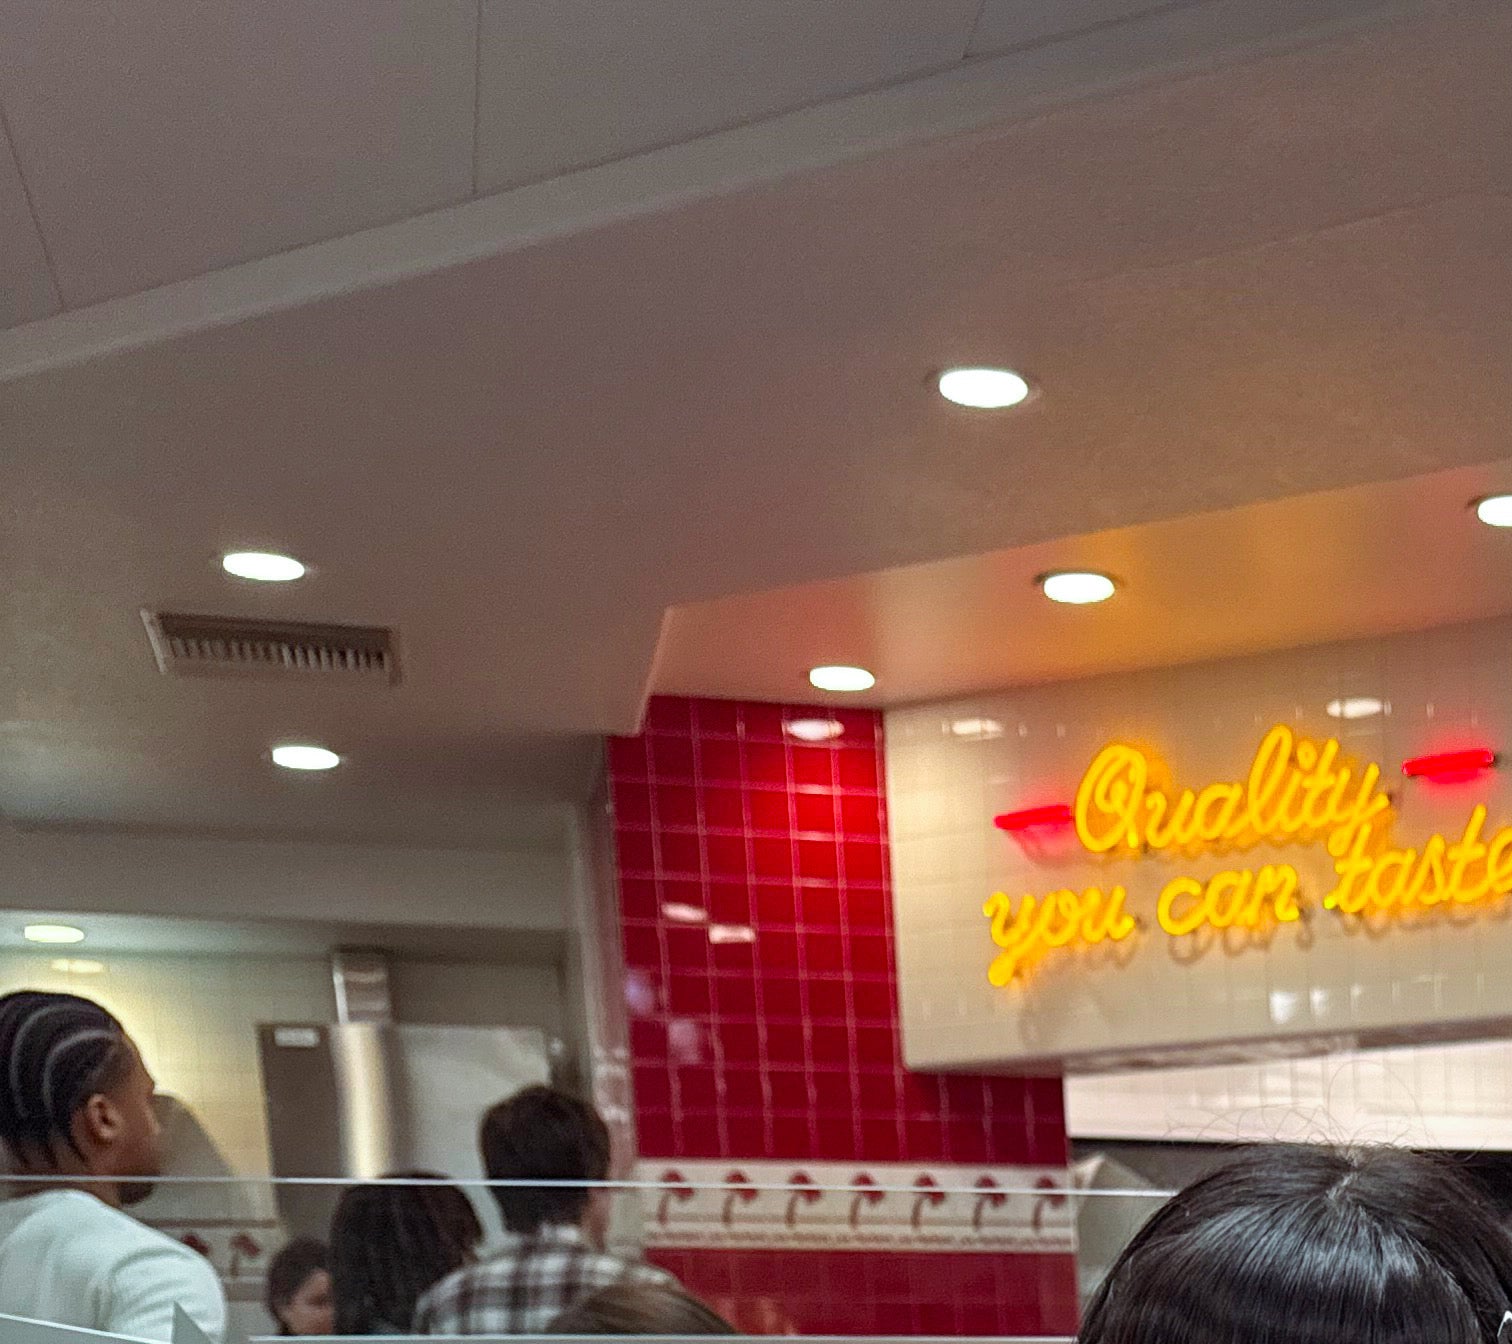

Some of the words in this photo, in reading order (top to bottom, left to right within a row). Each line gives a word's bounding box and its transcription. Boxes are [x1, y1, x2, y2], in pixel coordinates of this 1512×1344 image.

[1075, 723, 1391, 856] Quality
[982, 885, 1135, 987] you
[1157, 864, 1299, 935] can
